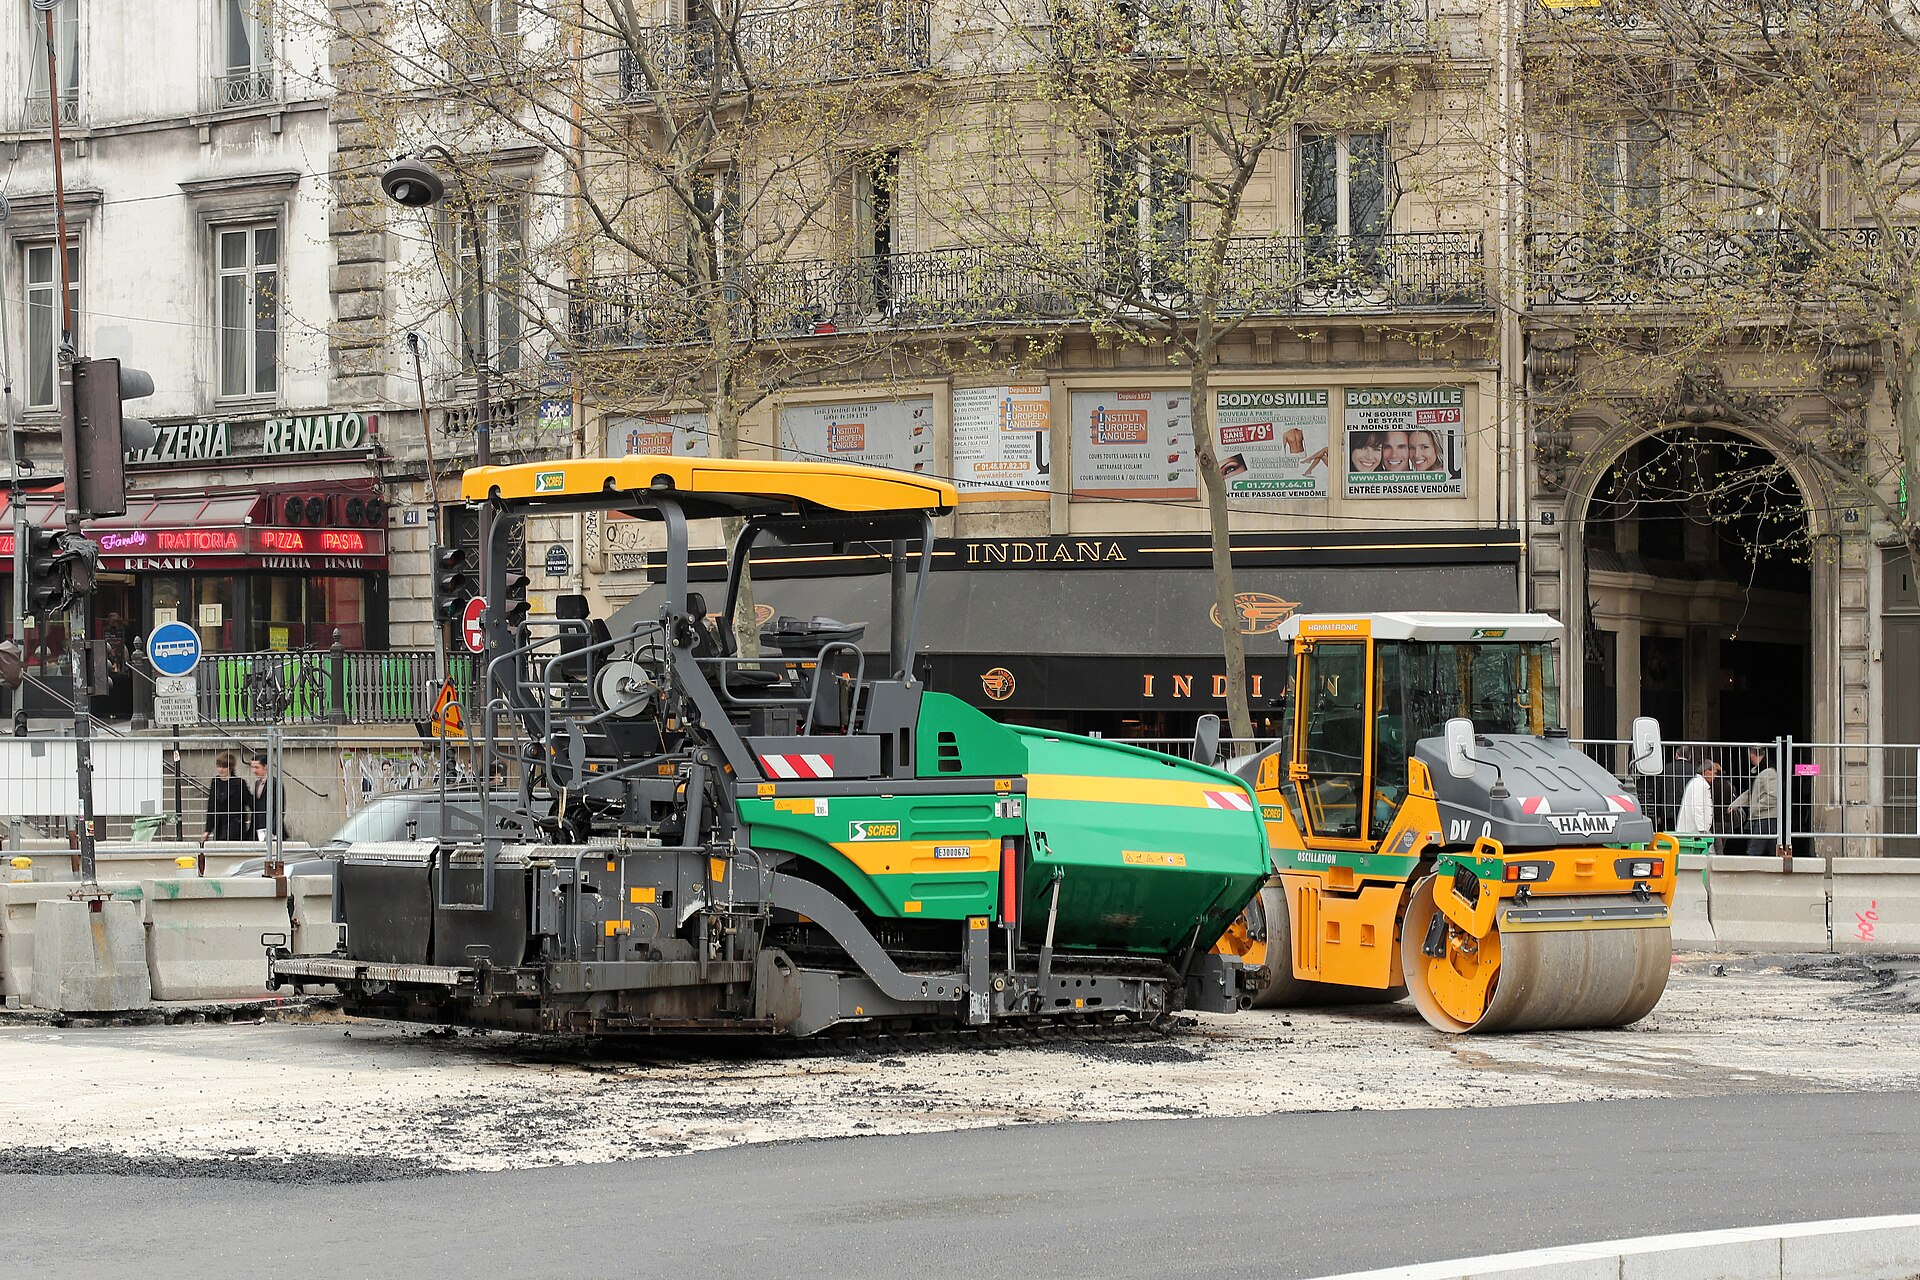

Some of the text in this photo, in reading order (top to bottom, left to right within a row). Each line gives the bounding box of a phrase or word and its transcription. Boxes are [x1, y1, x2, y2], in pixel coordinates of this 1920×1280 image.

[1007, 403, 1043, 412] INSTITUT
[1006, 412, 1048, 420] EUROPEEN
[1099, 413, 1140, 422] INSTITUT
[1439, 410, 1459, 422] 79€
[1006, 420, 1040, 430] LANGUES
[1098, 423, 1146, 432] EUROPEEN
[832, 427, 859, 435] INSTITUT
[1223, 431, 1244, 440] SANS
[1248, 425, 1271, 441] 79€
[125, 412, 364, 463] ZZERIA RENATO
[633, 436, 666, 446] INSTITUT
[832, 434, 864, 442] EUROPEEN
[1098, 432, 1137, 443] LANGUES
[632, 445, 671, 454] EUROPEEN
[832, 441, 858, 451] LANGUES
[981, 462, 1027, 470] 01.48.87.82.36
[545, 475, 563, 487] SCREG
[1350, 473, 1443, 482] www.bodynsmile.fr
[1247, 481, 1313, 489] 01.77.19.64.15
[1349, 483, 1461, 494] ENTRÉE PASSAGE VENDÔME
[1226, 490, 1250, 498] NTRÉE
[406, 513, 416, 523] 41
[101, 531, 237, 549] Family TRATTORIA
[264, 532, 363, 549] PIZZA PASTA
[966, 541, 1128, 564] INDIANA
[124, 557, 194, 570] RENATO
[262, 557, 363, 569] PIZZERIA RENATO
[1308, 624, 1358, 632] HAMMTRONIC
[1263, 808, 1281, 819] SCREG
[1450, 819, 1471, 841] DV
[1559, 817, 1610, 834] HAMM
[867, 825, 897, 837] SCREG
[1297, 852, 1336, 864] OSCILLATION
